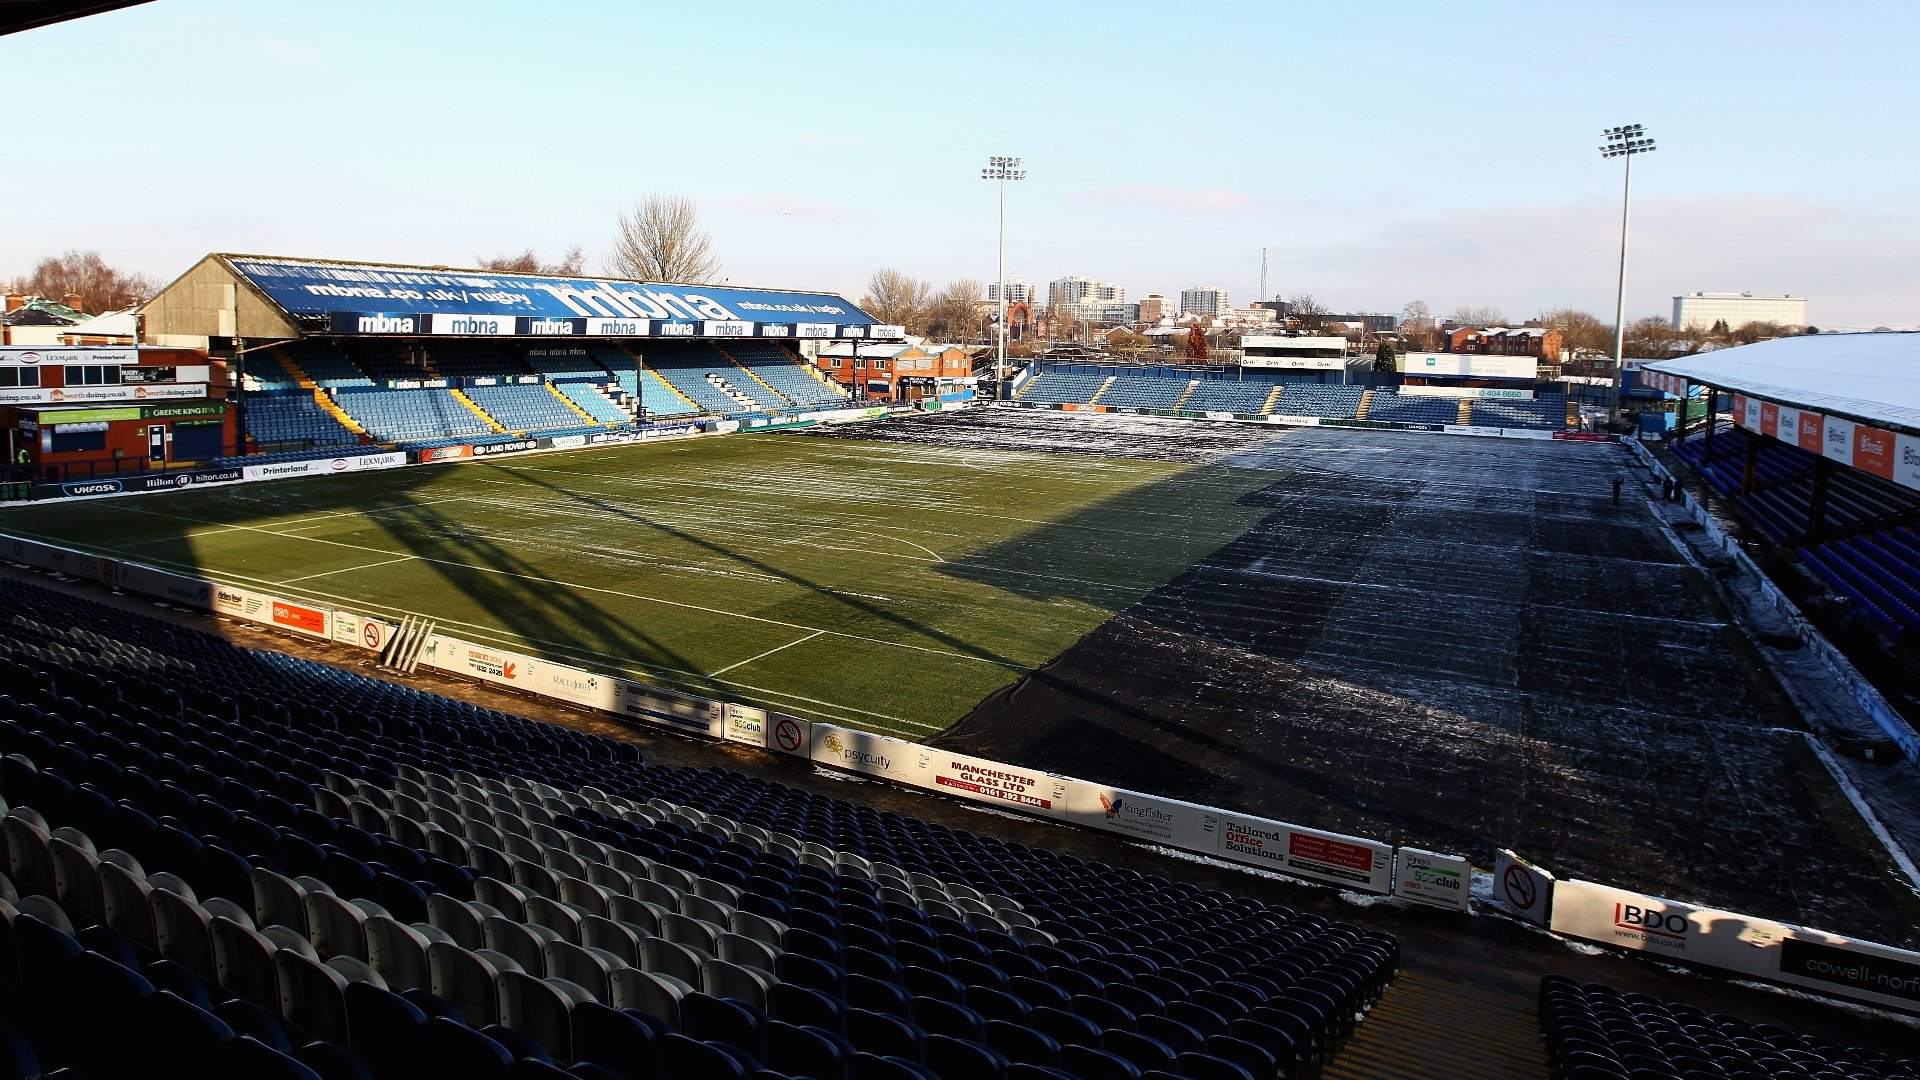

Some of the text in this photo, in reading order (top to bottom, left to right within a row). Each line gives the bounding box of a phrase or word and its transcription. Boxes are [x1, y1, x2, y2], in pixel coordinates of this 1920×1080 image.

[534, 282, 742, 321] mbna
[359, 313, 413, 333] mbna
[452, 317, 498, 334] mbna
[532, 318, 573, 334] mbna
[601, 320, 636, 335] mbna
[661, 320, 694, 335] mbna
[715, 322, 743, 335] mbna
[762, 323, 789, 337] mbna
[805, 326, 828, 337] mbna
[843, 324, 865, 337] mbna
[877, 327, 897, 338] mbna
[529, 348, 586, 356] mbna mbna mbna
[396, 380, 421, 389] mbna
[423, 379, 447, 388] mbna
[475, 377, 497, 386] mbna
[518, 375, 539, 384] mbna
[1487, 389, 1501, 397] 404
[153, 408, 182, 417] GREENE
[183, 407, 201, 415] KING
[486, 441, 526, 454] LAND ROVER
[359, 455, 396, 467] LEXMARK
[147, 477, 175, 488] Hilton
[195, 471, 240, 483] hilton.co.uk
[477, 664, 488, 673] 832
[488, 667, 503, 677] 2429
[845, 749, 891, 769] psycuity
[951, 761, 1036, 787] MANCHESTER
[960, 772, 1000, 788] GLASS
[1002, 781, 1026, 793] LTD
[980, 786, 1042, 807] 0161 292 8444
[1124, 802, 1173, 821] kingfisher
[1226, 821, 1280, 841] Tailored
[1226, 831, 1263, 847] Office
[1225, 840, 1284, 862] Solutions
[1624, 904, 1689, 934] BDO
[1614, 928, 1687, 950] www.bdo.co.uk
